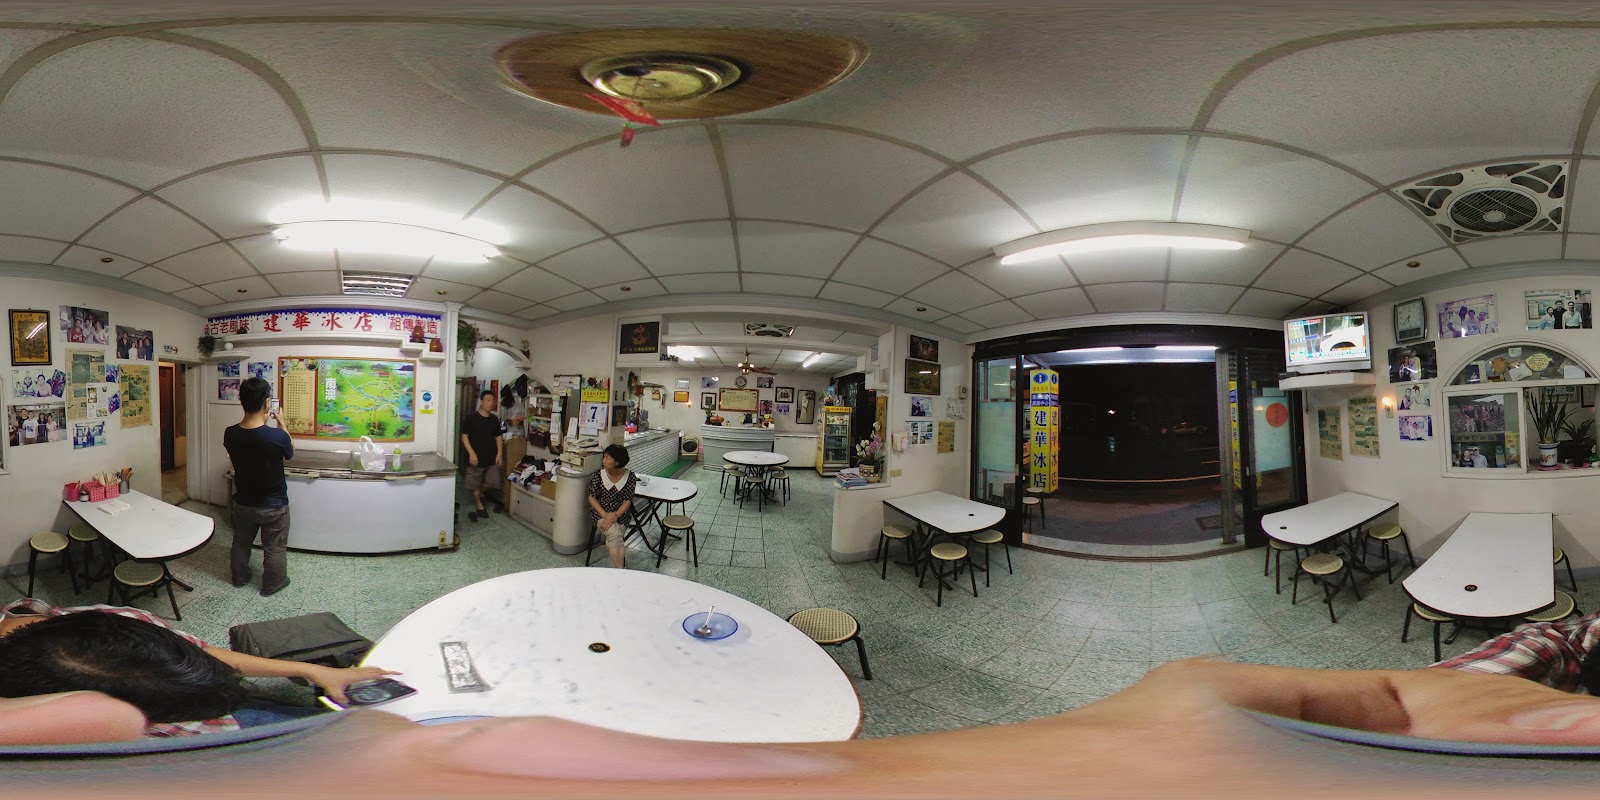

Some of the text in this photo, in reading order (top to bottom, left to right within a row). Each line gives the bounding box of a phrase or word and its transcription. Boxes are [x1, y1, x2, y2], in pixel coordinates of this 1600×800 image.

[264, 312, 373, 332] 建華冰店
[590, 406, 598, 420] 7
[1034, 411, 1047, 488] 建華冰店
